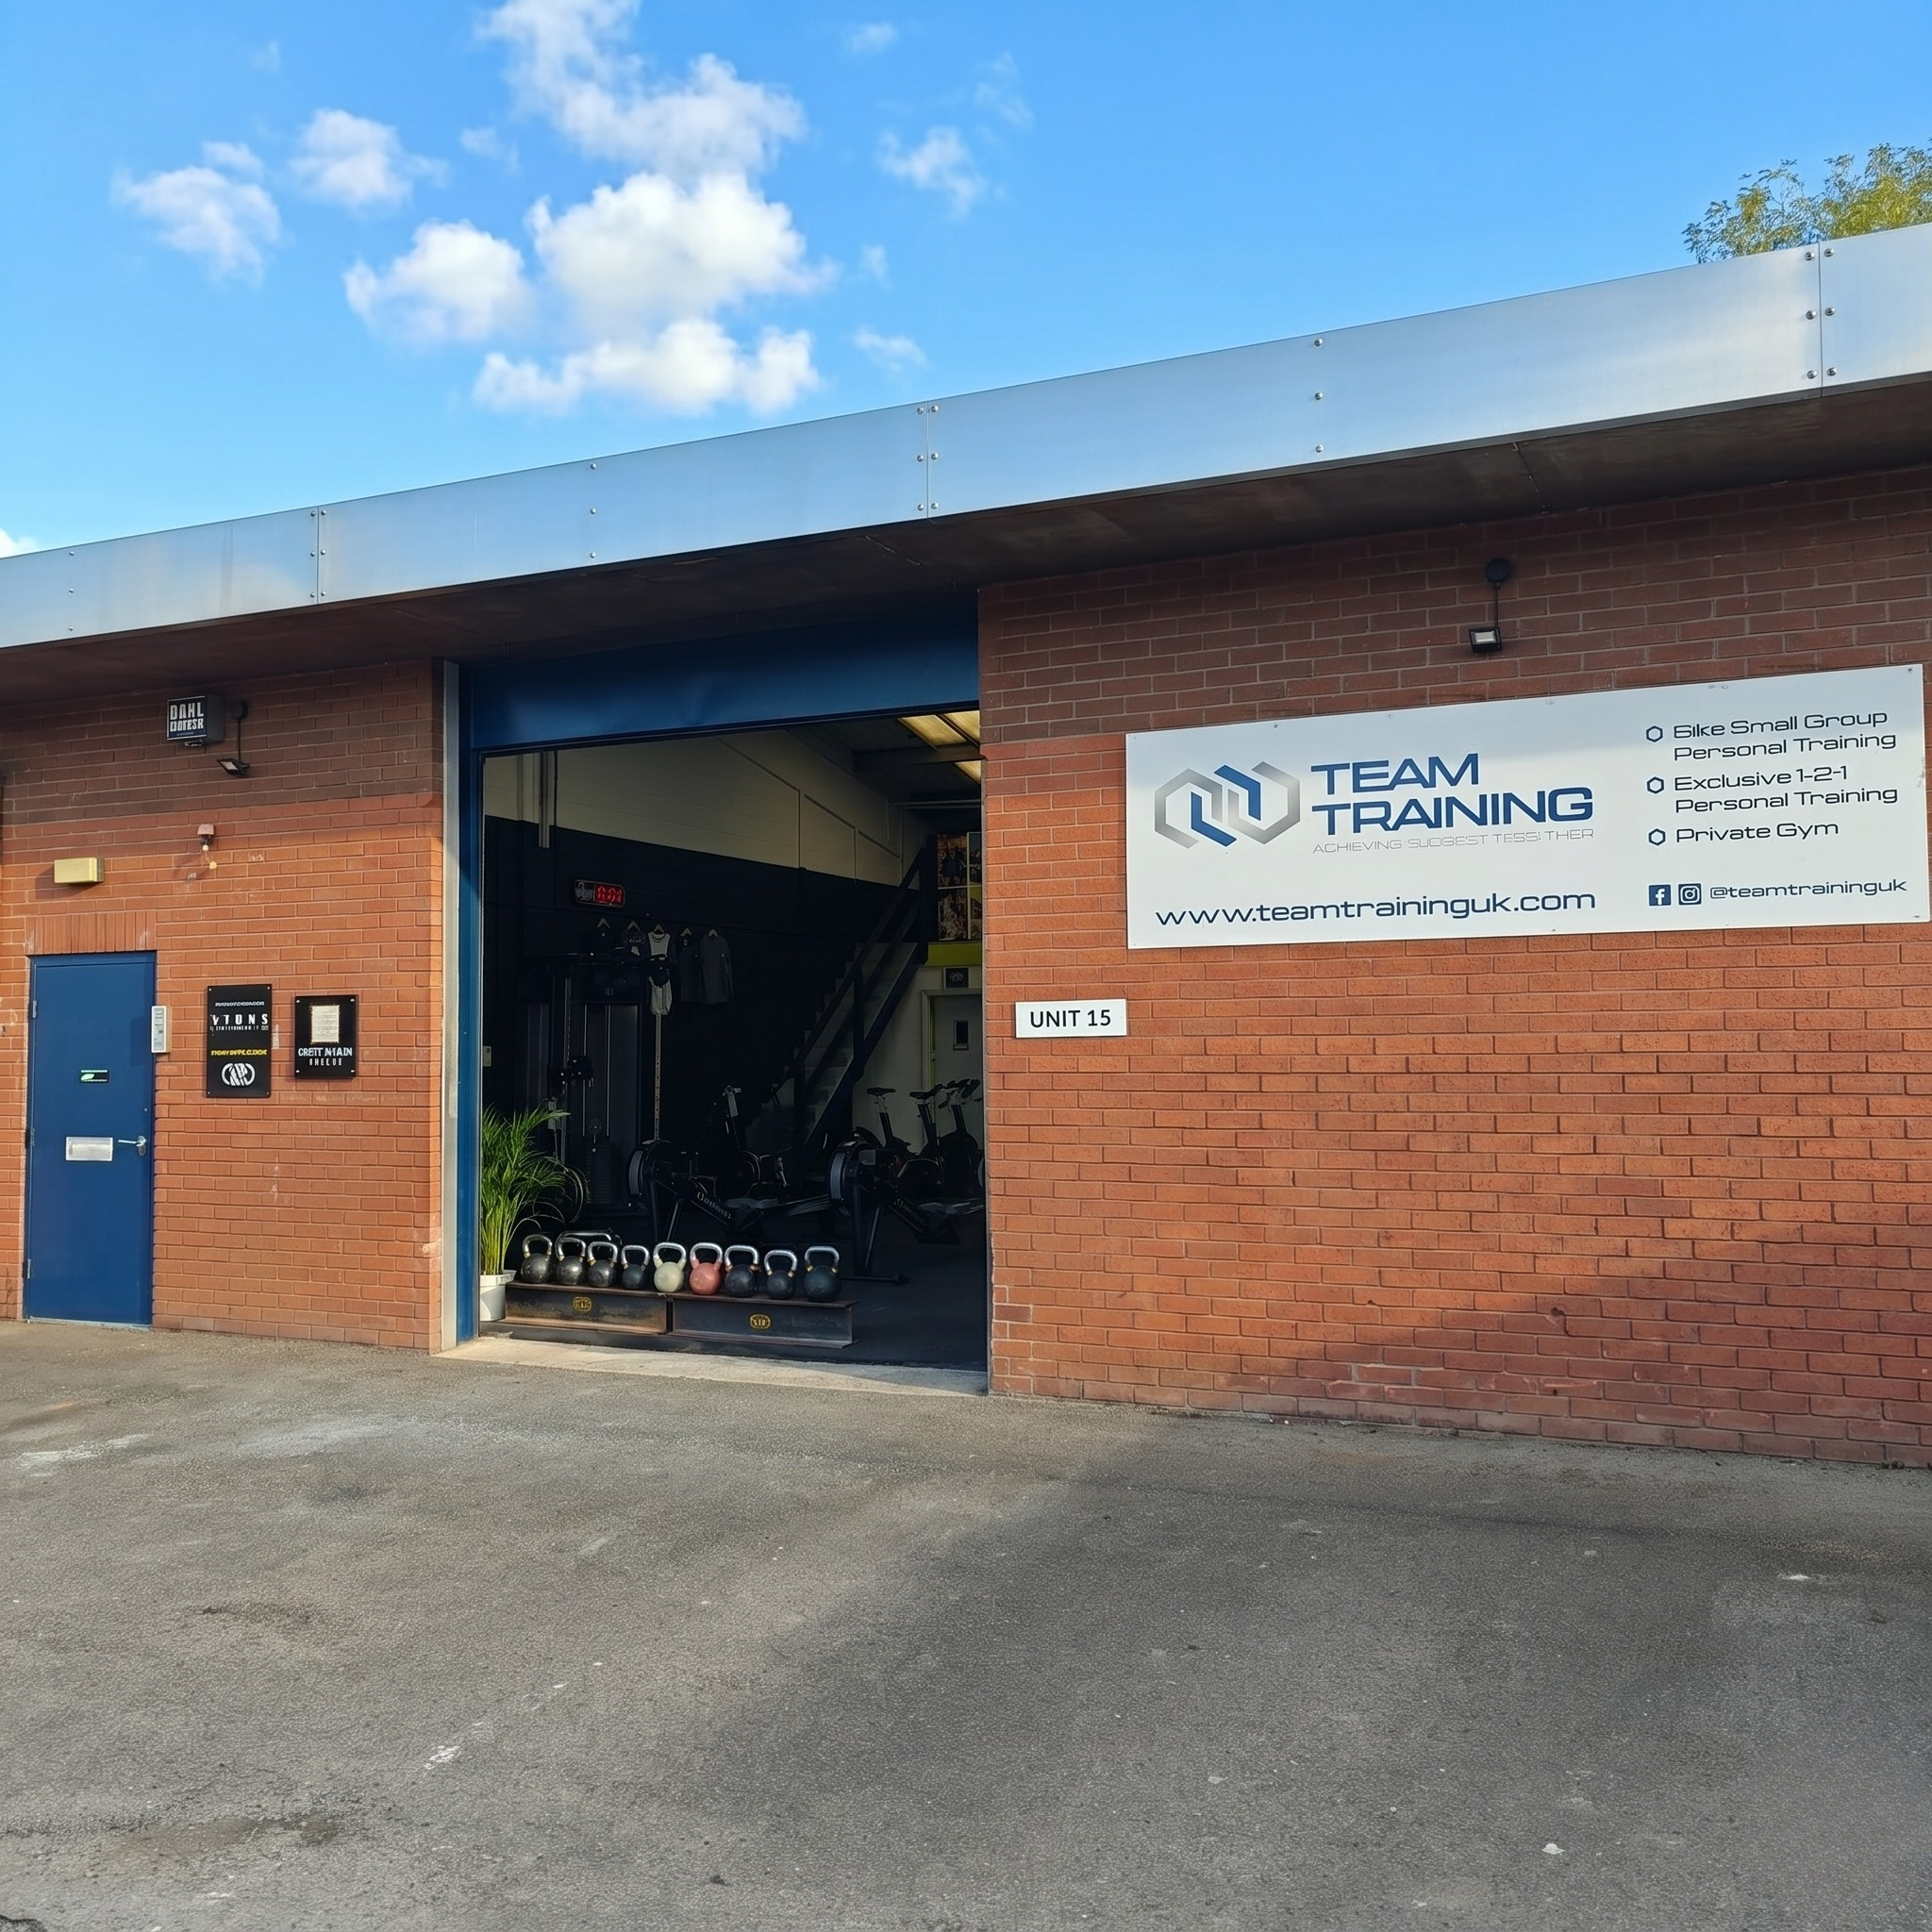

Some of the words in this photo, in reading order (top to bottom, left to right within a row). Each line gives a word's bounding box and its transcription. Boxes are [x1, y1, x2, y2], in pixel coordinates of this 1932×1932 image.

[1730, 716, 1797, 735] Small
[1804, 712, 1888, 729] Group
[1674, 740, 1787, 761] Personal
[1793, 733, 1896, 752] Training
[1311, 753, 1478, 795] TEAM
[1674, 772, 1792, 791] Exclusive
[1796, 765, 1848, 784] 1-2-1
[1311, 787, 1593, 836] TRAINING
[1675, 792, 1789, 813] Personal
[1793, 788, 1898, 806] Training
[1312, 840, 1403, 854] ACHIEVING
[1544, 828, 1594, 841] THER
[1676, 825, 1771, 842] Private
[1776, 823, 1839, 840] Gym
[1709, 878, 1907, 900] @teamtraininguk
[1156, 892, 1596, 926] www.teamtraininguk.com
[1030, 1009, 1081, 1028] UNIT
[1087, 1009, 1111, 1026] 15
